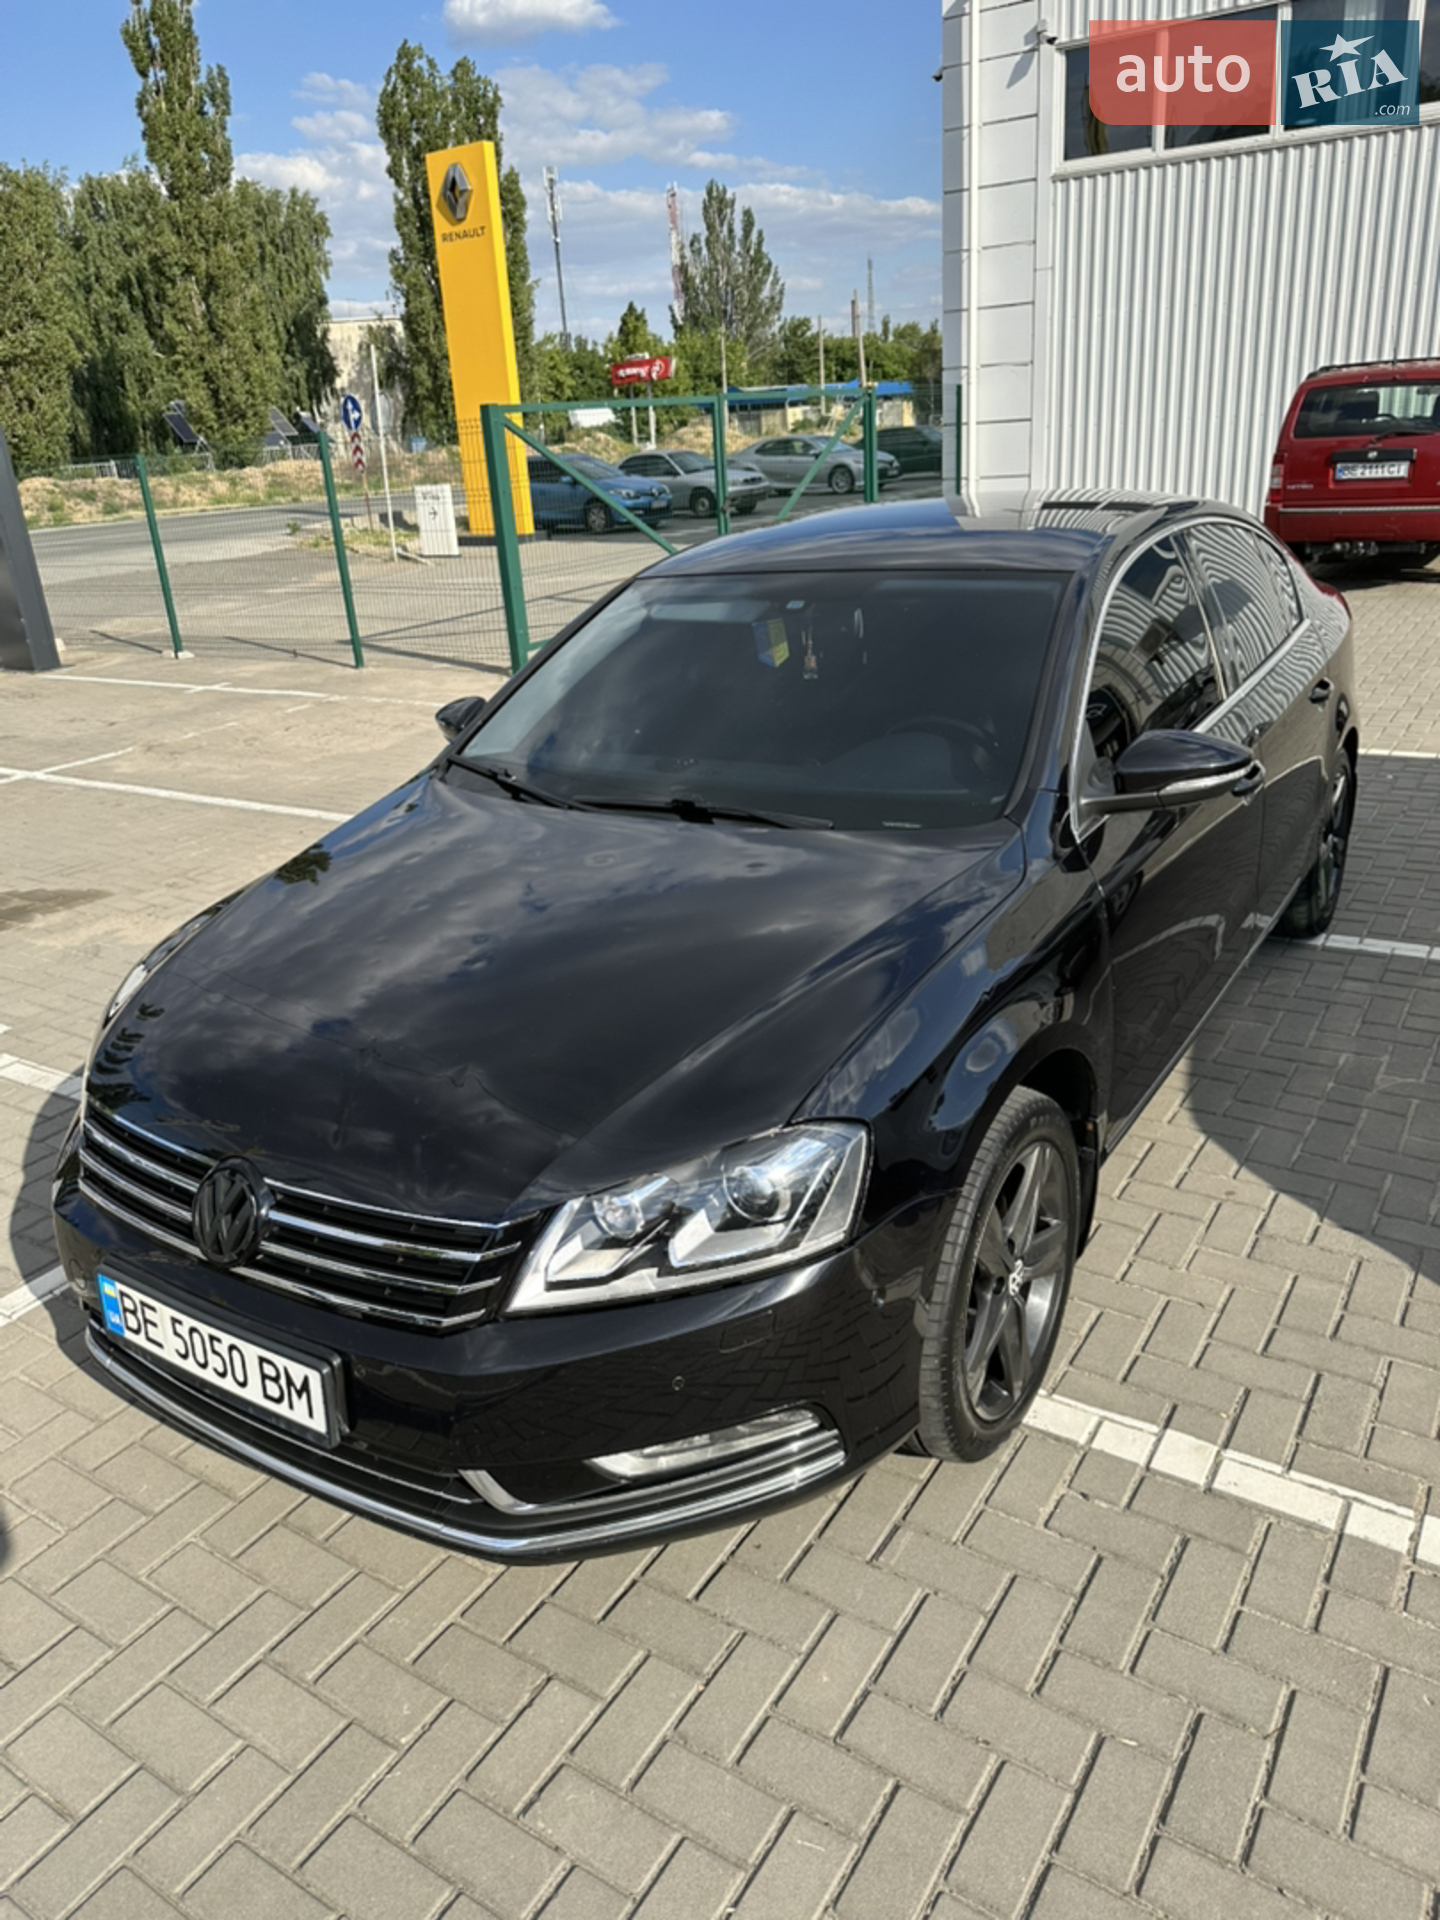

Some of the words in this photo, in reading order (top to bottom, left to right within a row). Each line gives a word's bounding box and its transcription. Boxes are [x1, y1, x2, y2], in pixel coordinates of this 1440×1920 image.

[441, 226, 486, 243] RENAULT
[119, 1289, 165, 1349] BE
[170, 1315, 249, 1389] 5050
[258, 1355, 314, 1420] BM
